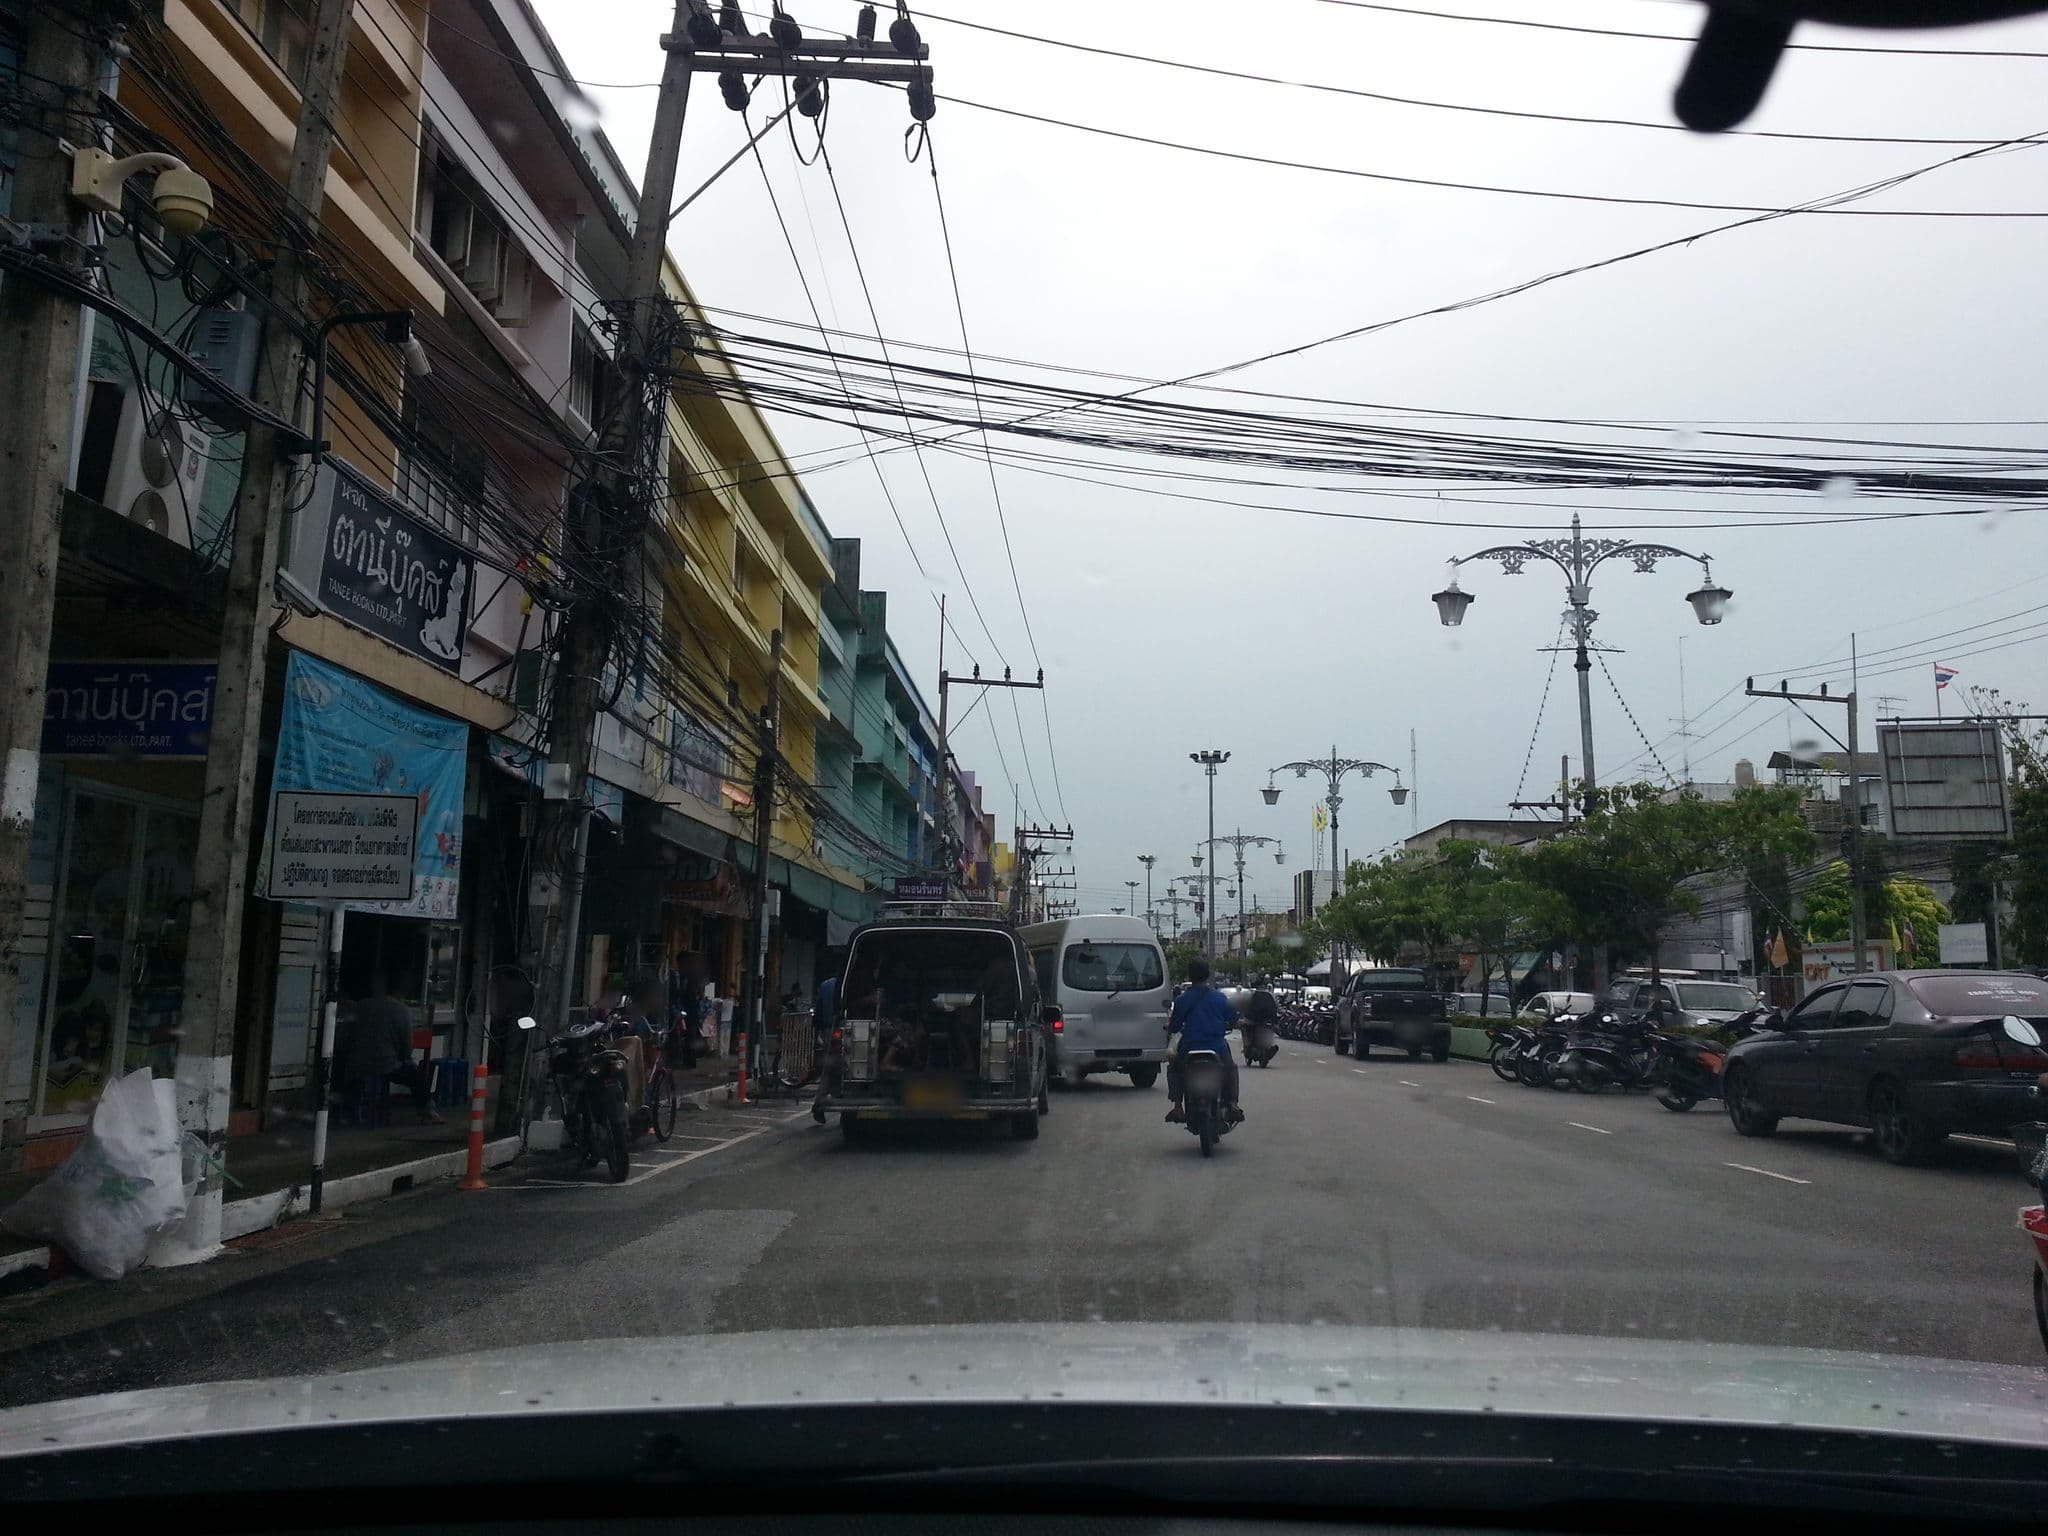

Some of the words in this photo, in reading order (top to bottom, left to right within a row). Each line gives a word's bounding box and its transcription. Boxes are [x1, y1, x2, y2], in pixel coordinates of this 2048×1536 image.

[328, 577, 352, 602] TANEE
[351, 590, 376, 616] BOOKS
[332, 513, 449, 615] ตานีบุ๊คส์
